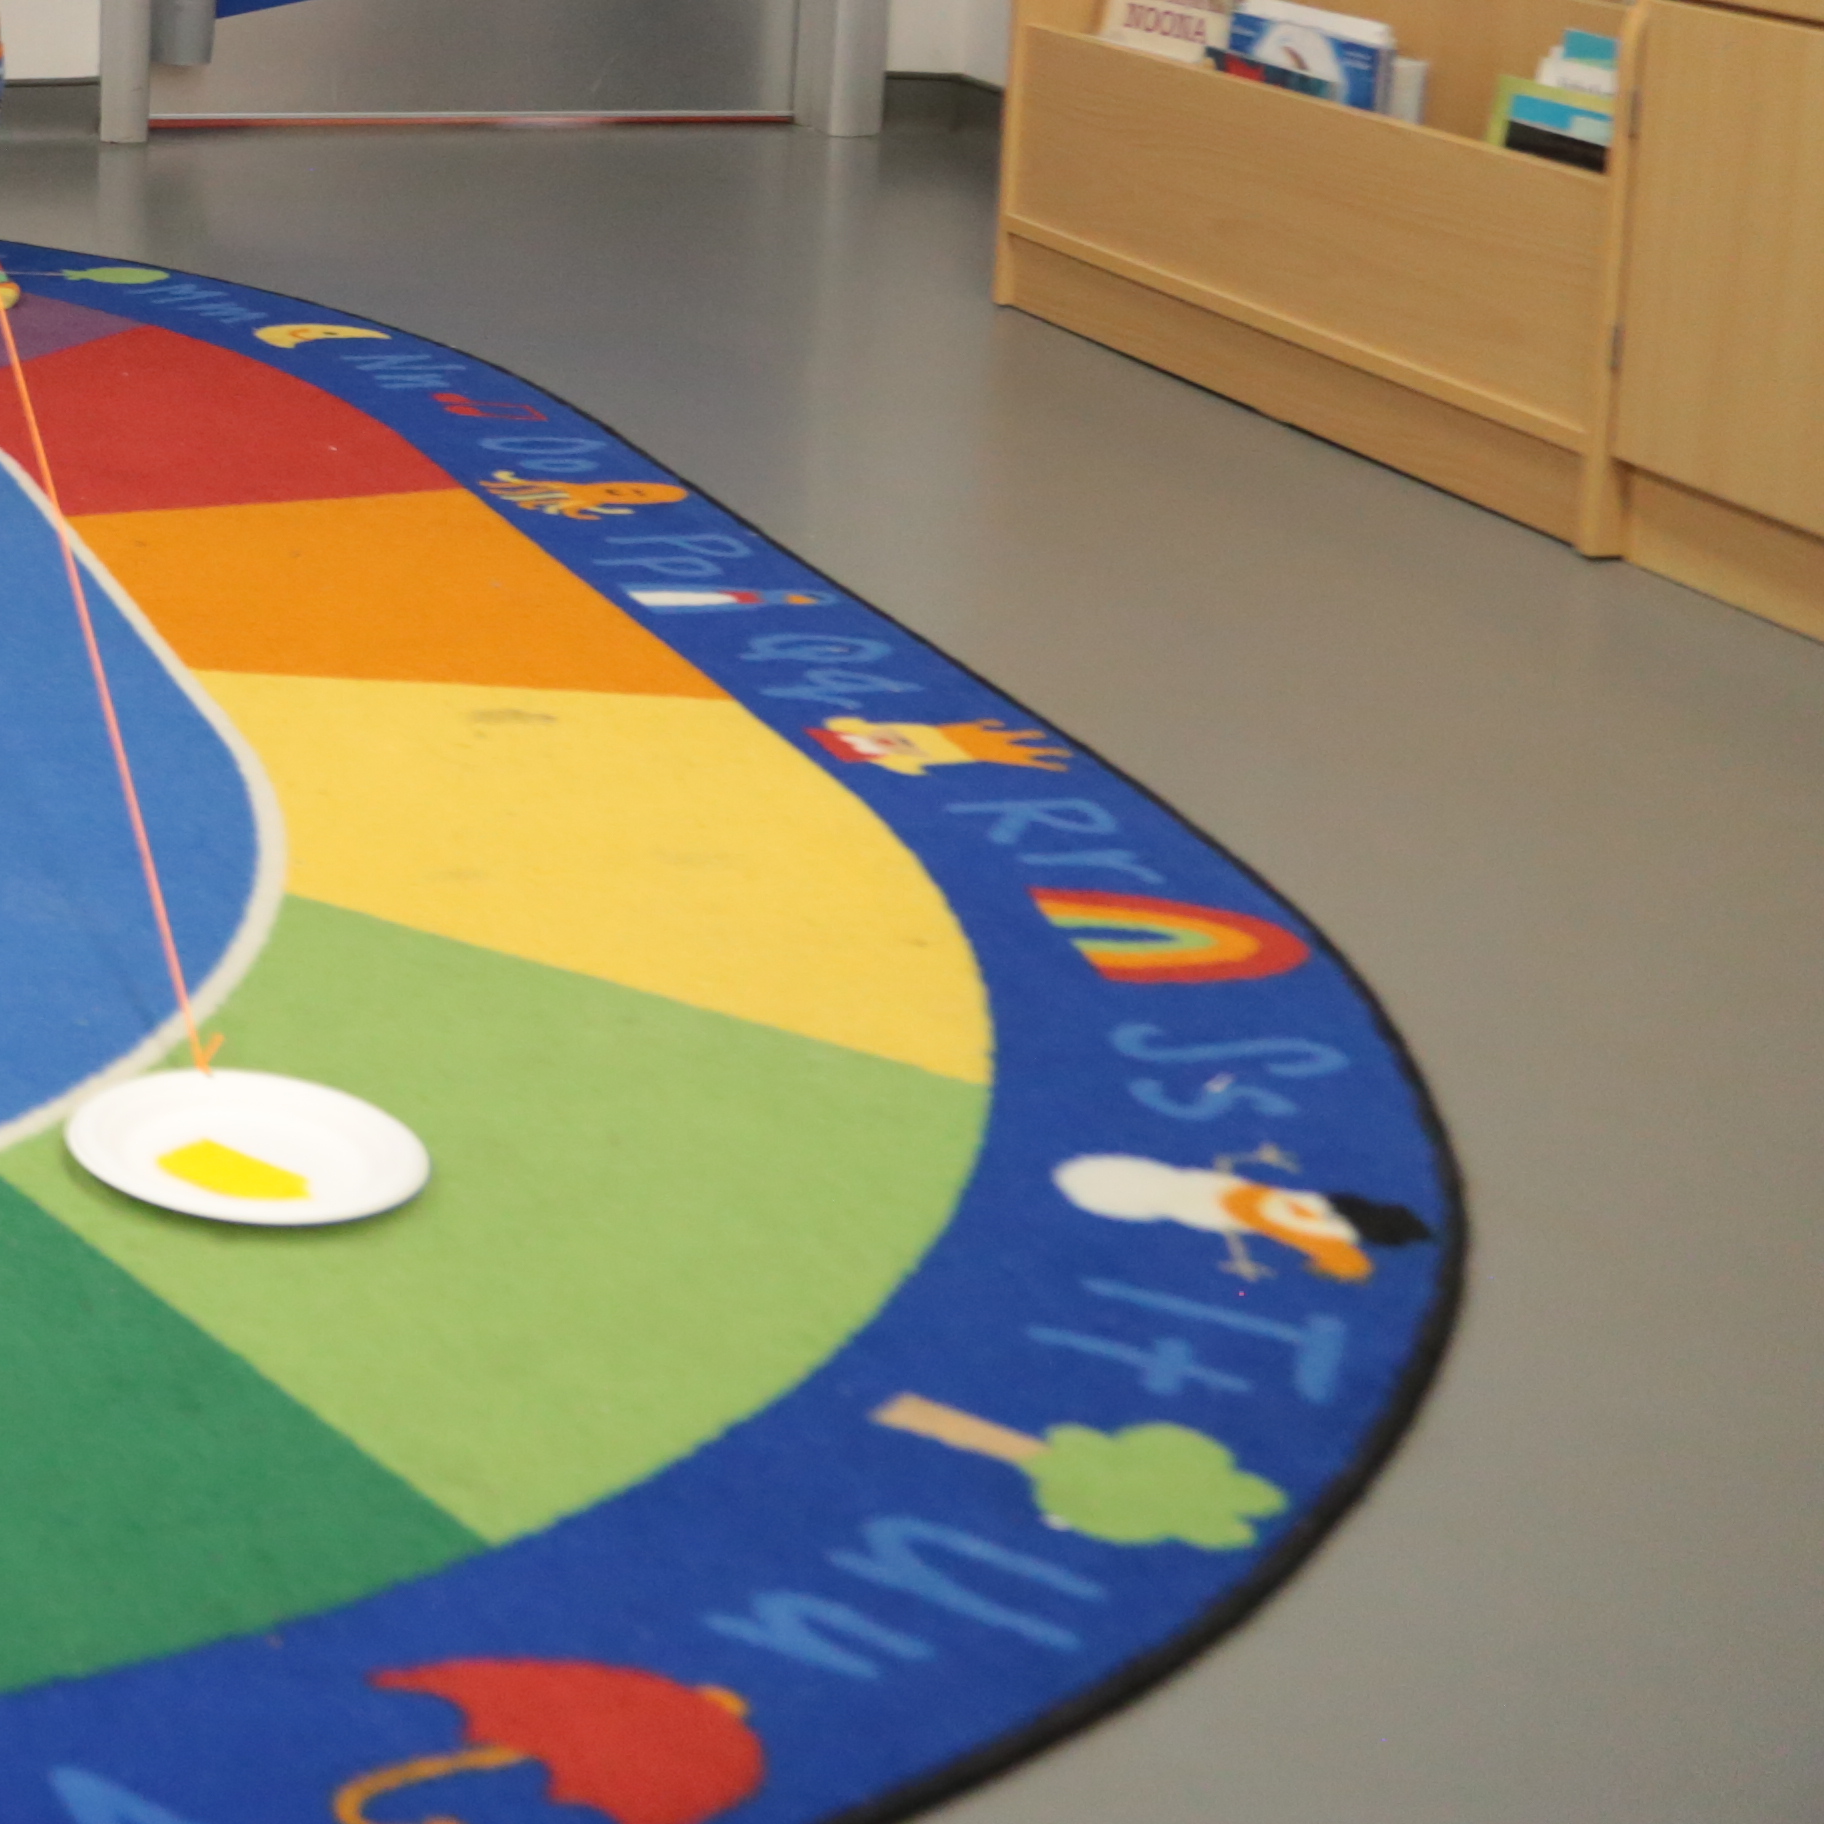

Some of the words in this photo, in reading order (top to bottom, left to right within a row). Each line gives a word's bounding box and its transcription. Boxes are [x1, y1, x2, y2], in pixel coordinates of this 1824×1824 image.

[594, 532, 752, 576] Pp
[741, 633, 923, 709] Qq
[946, 797, 1166, 885] Rr
[1108, 1023, 1349, 1119] Ss
